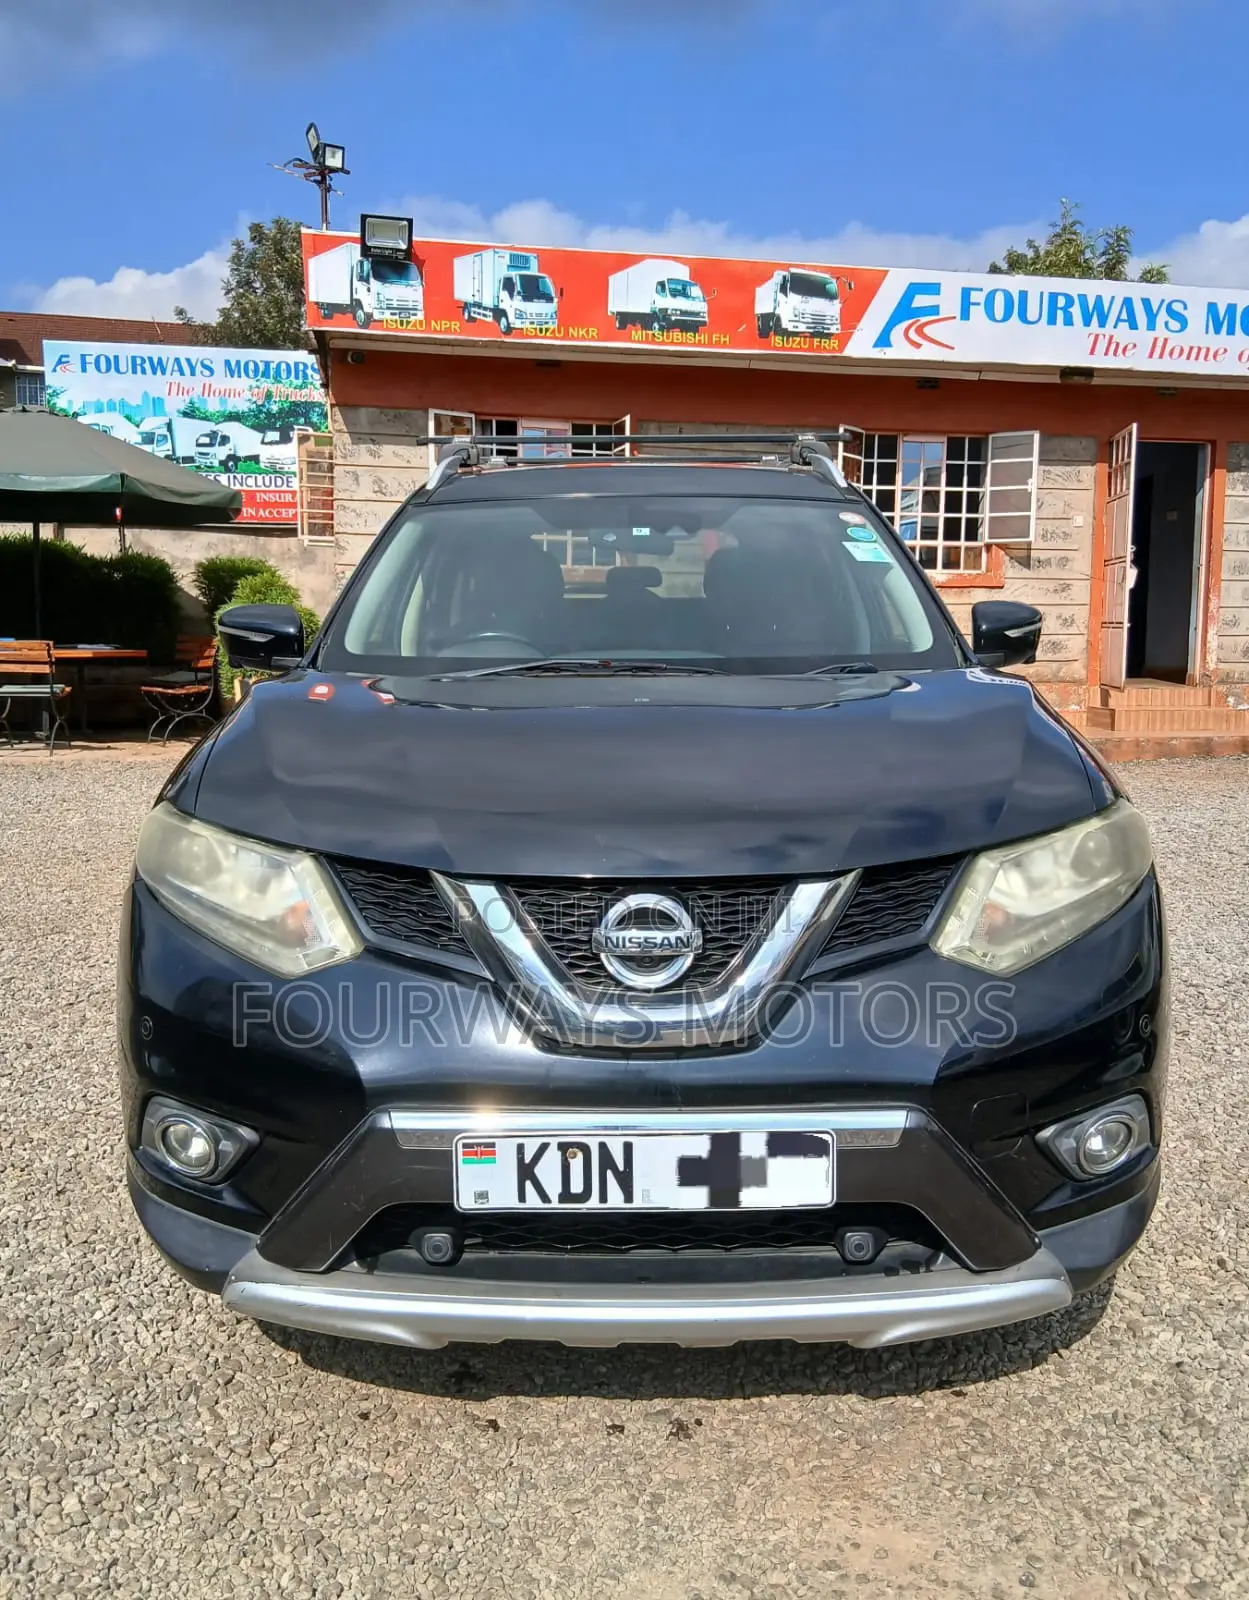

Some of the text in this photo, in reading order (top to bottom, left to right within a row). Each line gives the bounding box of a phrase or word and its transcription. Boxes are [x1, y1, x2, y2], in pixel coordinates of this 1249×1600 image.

[960, 286, 1188, 334] FOURWAYS
[383, 318, 461, 333] ISUZU NPR
[523, 325, 599, 340] ISUZU NKR
[631, 330, 730, 346] MITSUBISHI FH
[771, 336, 840, 350] ISUZU FRR
[1087, 332, 1249, 371] The Home o
[80, 352, 321, 382] FOURWAYS MOTORS
[166, 380, 326, 403] The Home of Trucks
[228, 474, 294, 489] INCLUDE
[256, 492, 297, 503] INSUR
[258, 507, 298, 519] ACCEP
[604, 935, 692, 950] NISSAN
[515, 1140, 635, 1205] KDN
